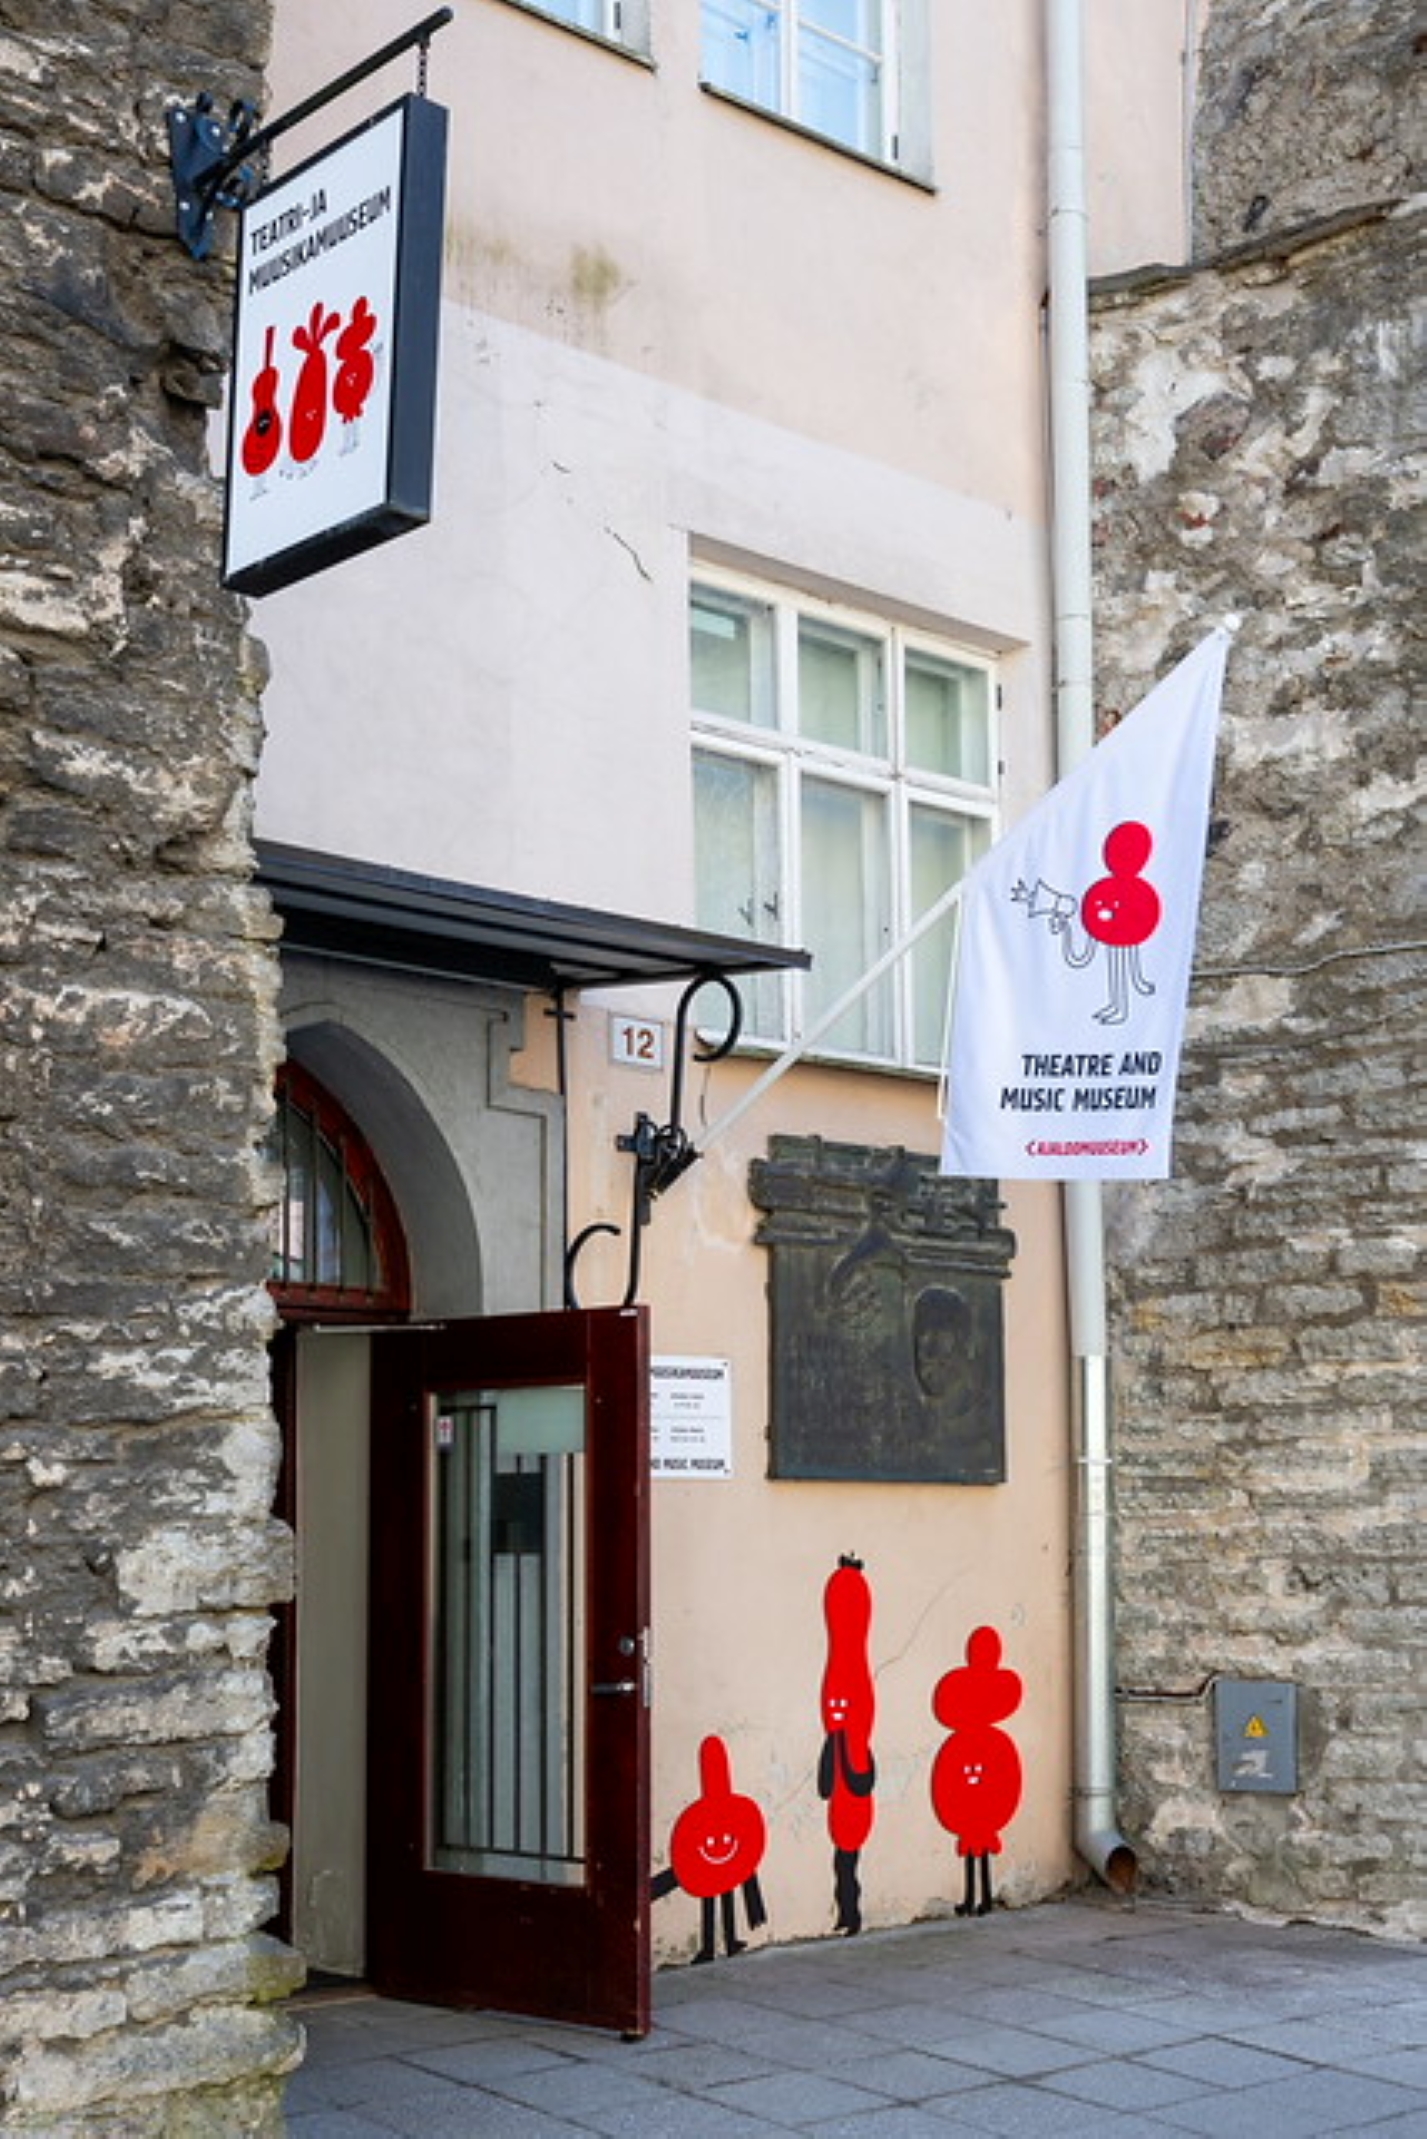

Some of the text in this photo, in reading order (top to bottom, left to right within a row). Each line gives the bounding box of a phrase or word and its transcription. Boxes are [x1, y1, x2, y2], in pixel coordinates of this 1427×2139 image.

[248, 185, 391, 295] MUUSIKAMUUSEUM
[621, 1026, 655, 1059] 12
[1022, 1051, 1162, 1077] THEATRE AND
[1001, 1086, 1156, 1112] MUSIC MUSEUM
